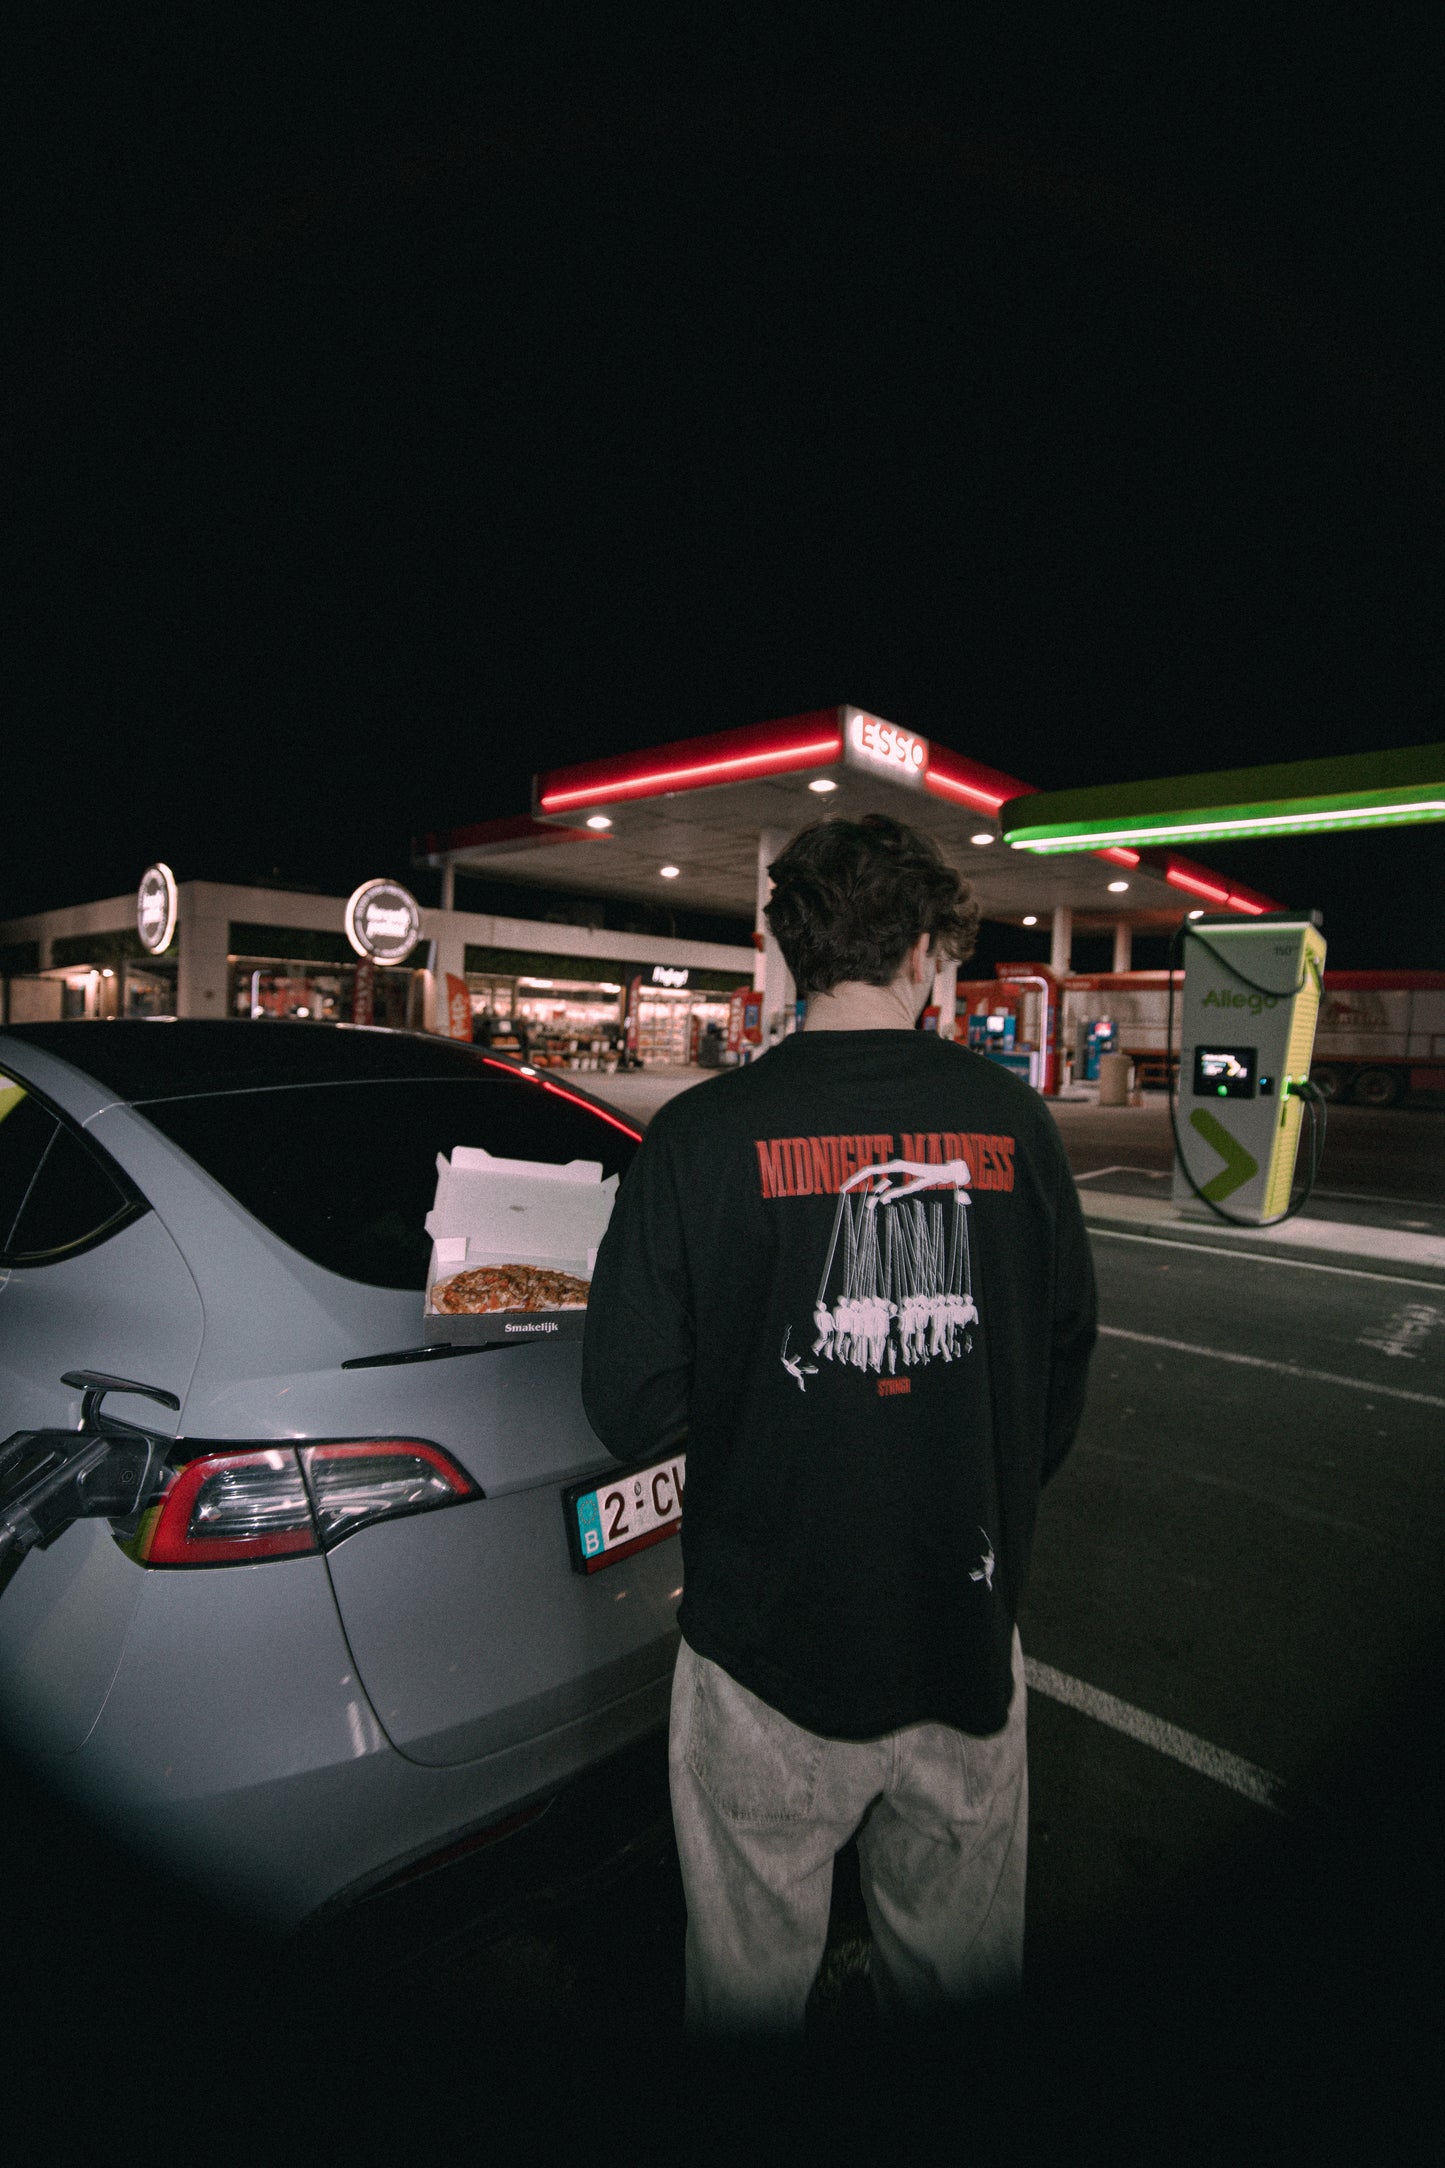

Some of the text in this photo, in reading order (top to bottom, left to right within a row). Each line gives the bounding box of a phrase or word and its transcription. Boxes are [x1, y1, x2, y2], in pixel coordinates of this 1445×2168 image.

[1203, 989, 1279, 1015] Allego
[504, 1322, 559, 1334] Smakelijk
[585, 1529, 600, 1554] B
